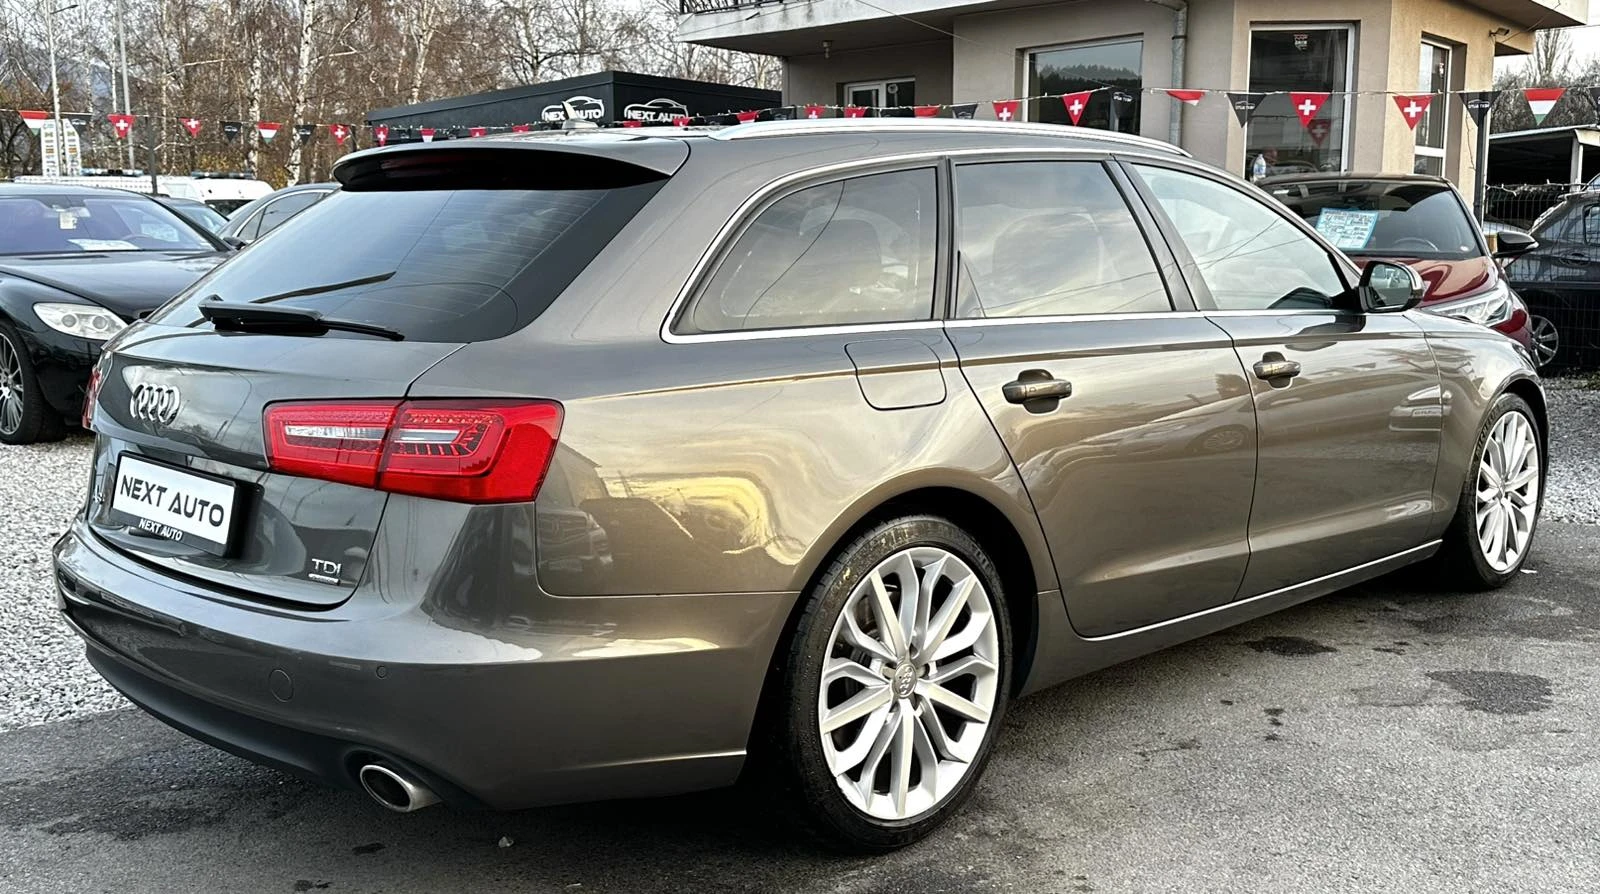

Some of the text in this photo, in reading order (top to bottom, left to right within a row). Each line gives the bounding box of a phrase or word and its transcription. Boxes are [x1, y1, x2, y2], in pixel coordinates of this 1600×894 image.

[544, 111, 570, 121] NEX
[627, 109, 656, 121] NEXT
[119, 474, 168, 507] NEXT
[168, 491, 225, 527] AUTO
[138, 518, 183, 541] NEXT AUTO
[311, 558, 342, 574] TDI
